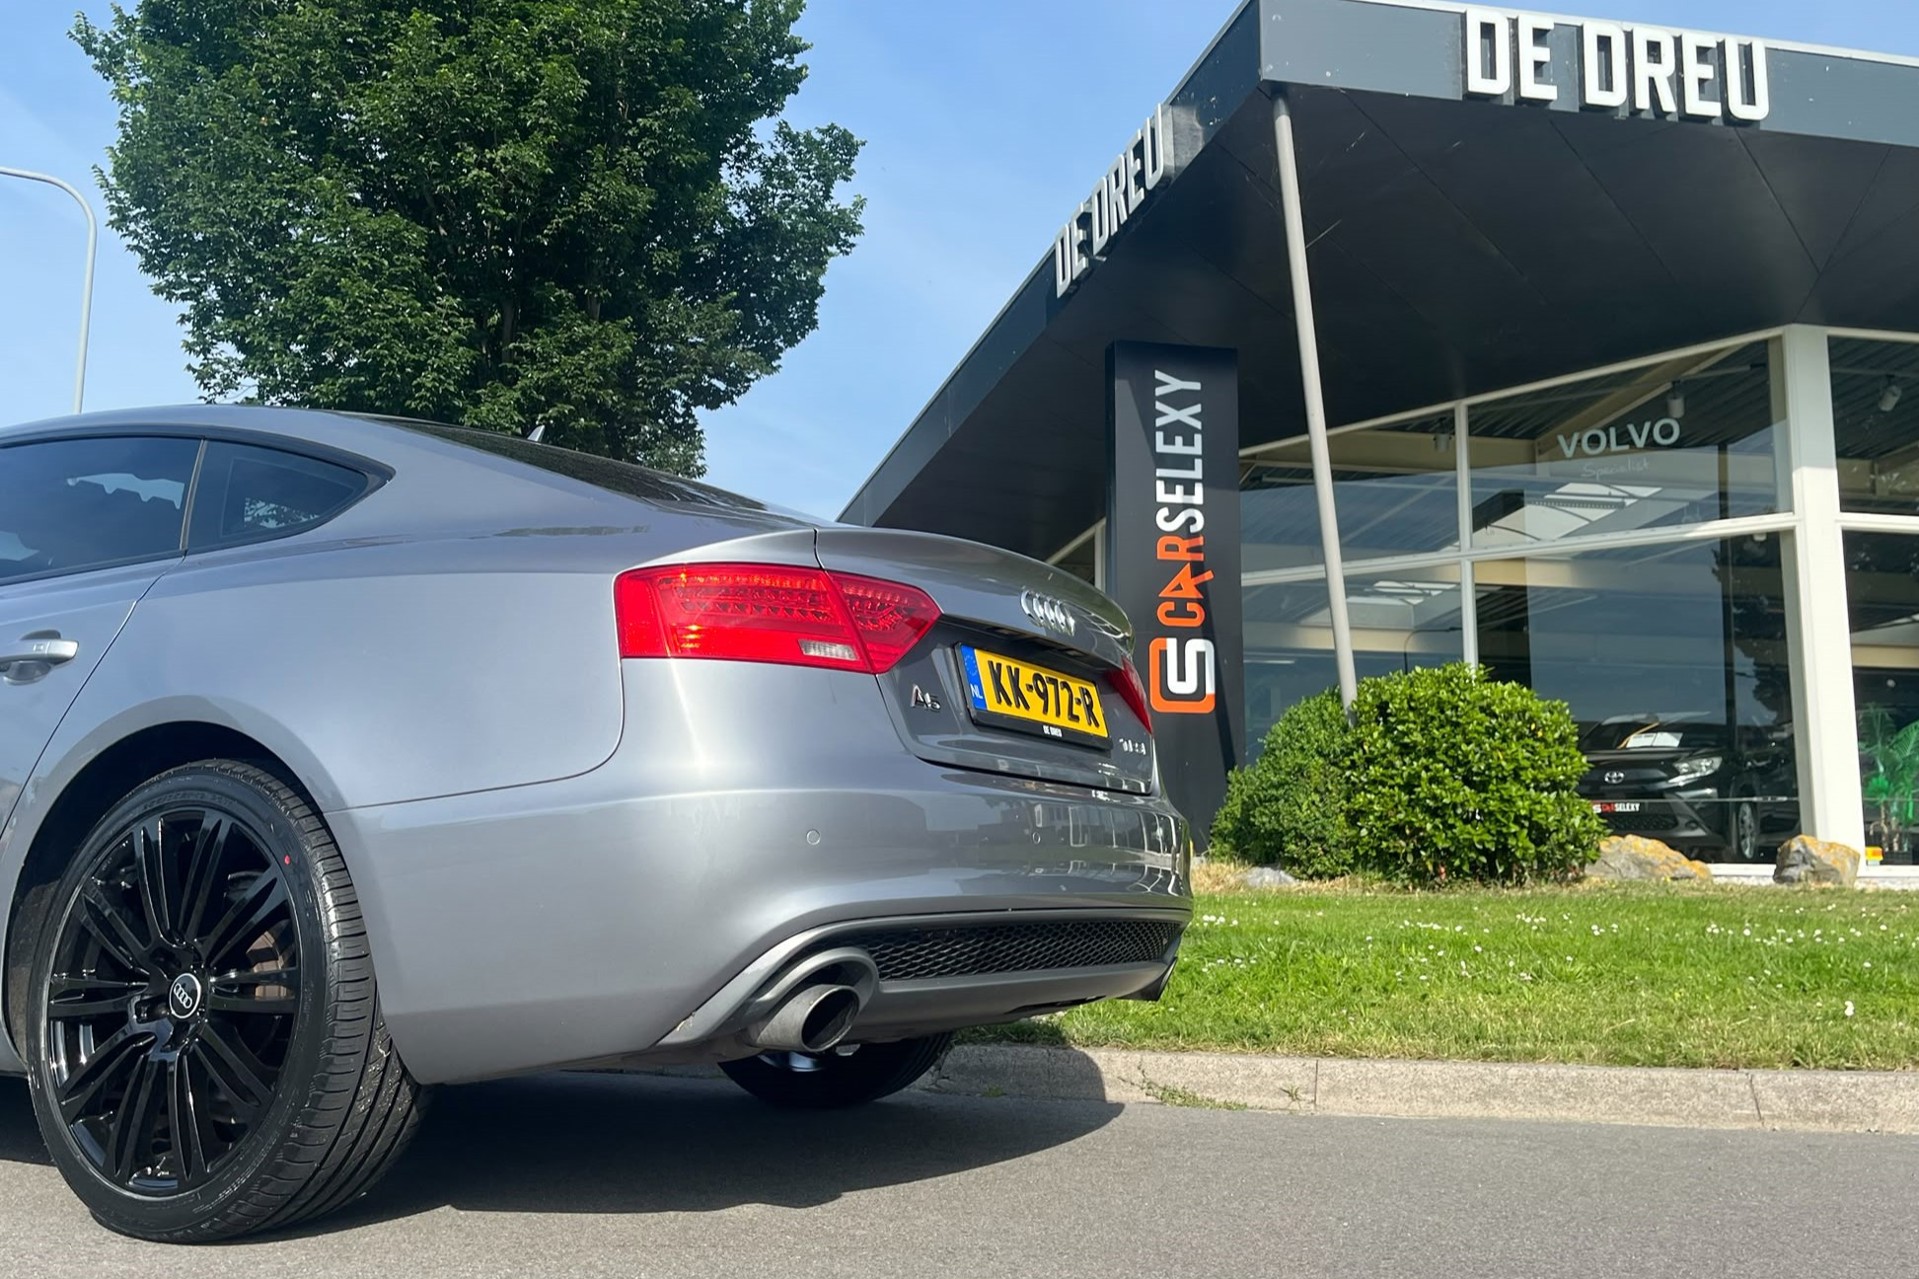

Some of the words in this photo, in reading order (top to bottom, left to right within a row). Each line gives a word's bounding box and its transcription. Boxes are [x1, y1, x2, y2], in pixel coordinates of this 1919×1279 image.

[1465, 8, 1557, 101] DE
[1582, 22, 1769, 121] DREU
[1055, 202, 1089, 298] DE
[1091, 103, 1164, 256] DREU
[1557, 417, 1681, 458] VOLVO
[911, 684, 941, 712] A5
[969, 683, 984, 700] NL
[988, 660, 1099, 728] KK-972-R
